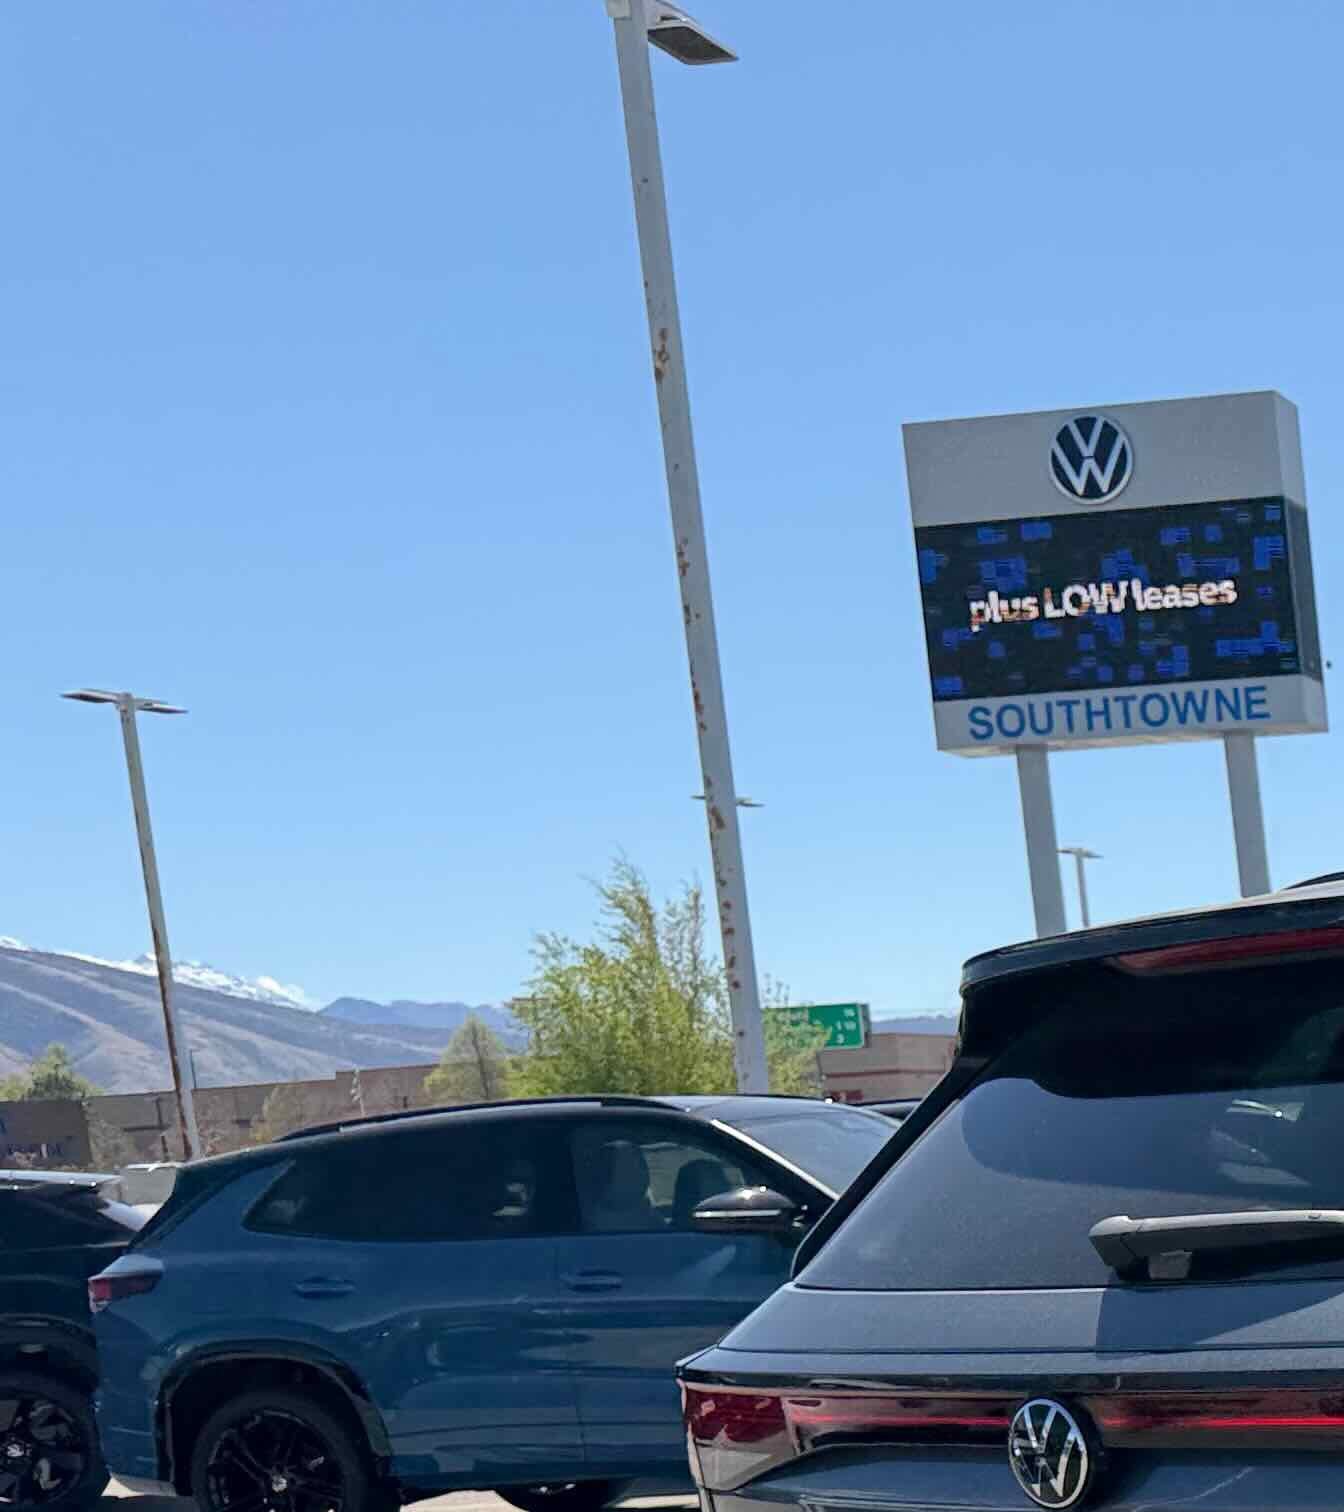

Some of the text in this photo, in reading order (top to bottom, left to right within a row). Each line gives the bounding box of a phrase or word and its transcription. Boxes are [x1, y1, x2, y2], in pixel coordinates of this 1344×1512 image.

[1048, 414, 1133, 503] VW
[969, 577, 1238, 632] plus LOW leases
[967, 685, 1271, 740] SOUTHTOWNE
[1008, 1398, 1088, 1509] VW
